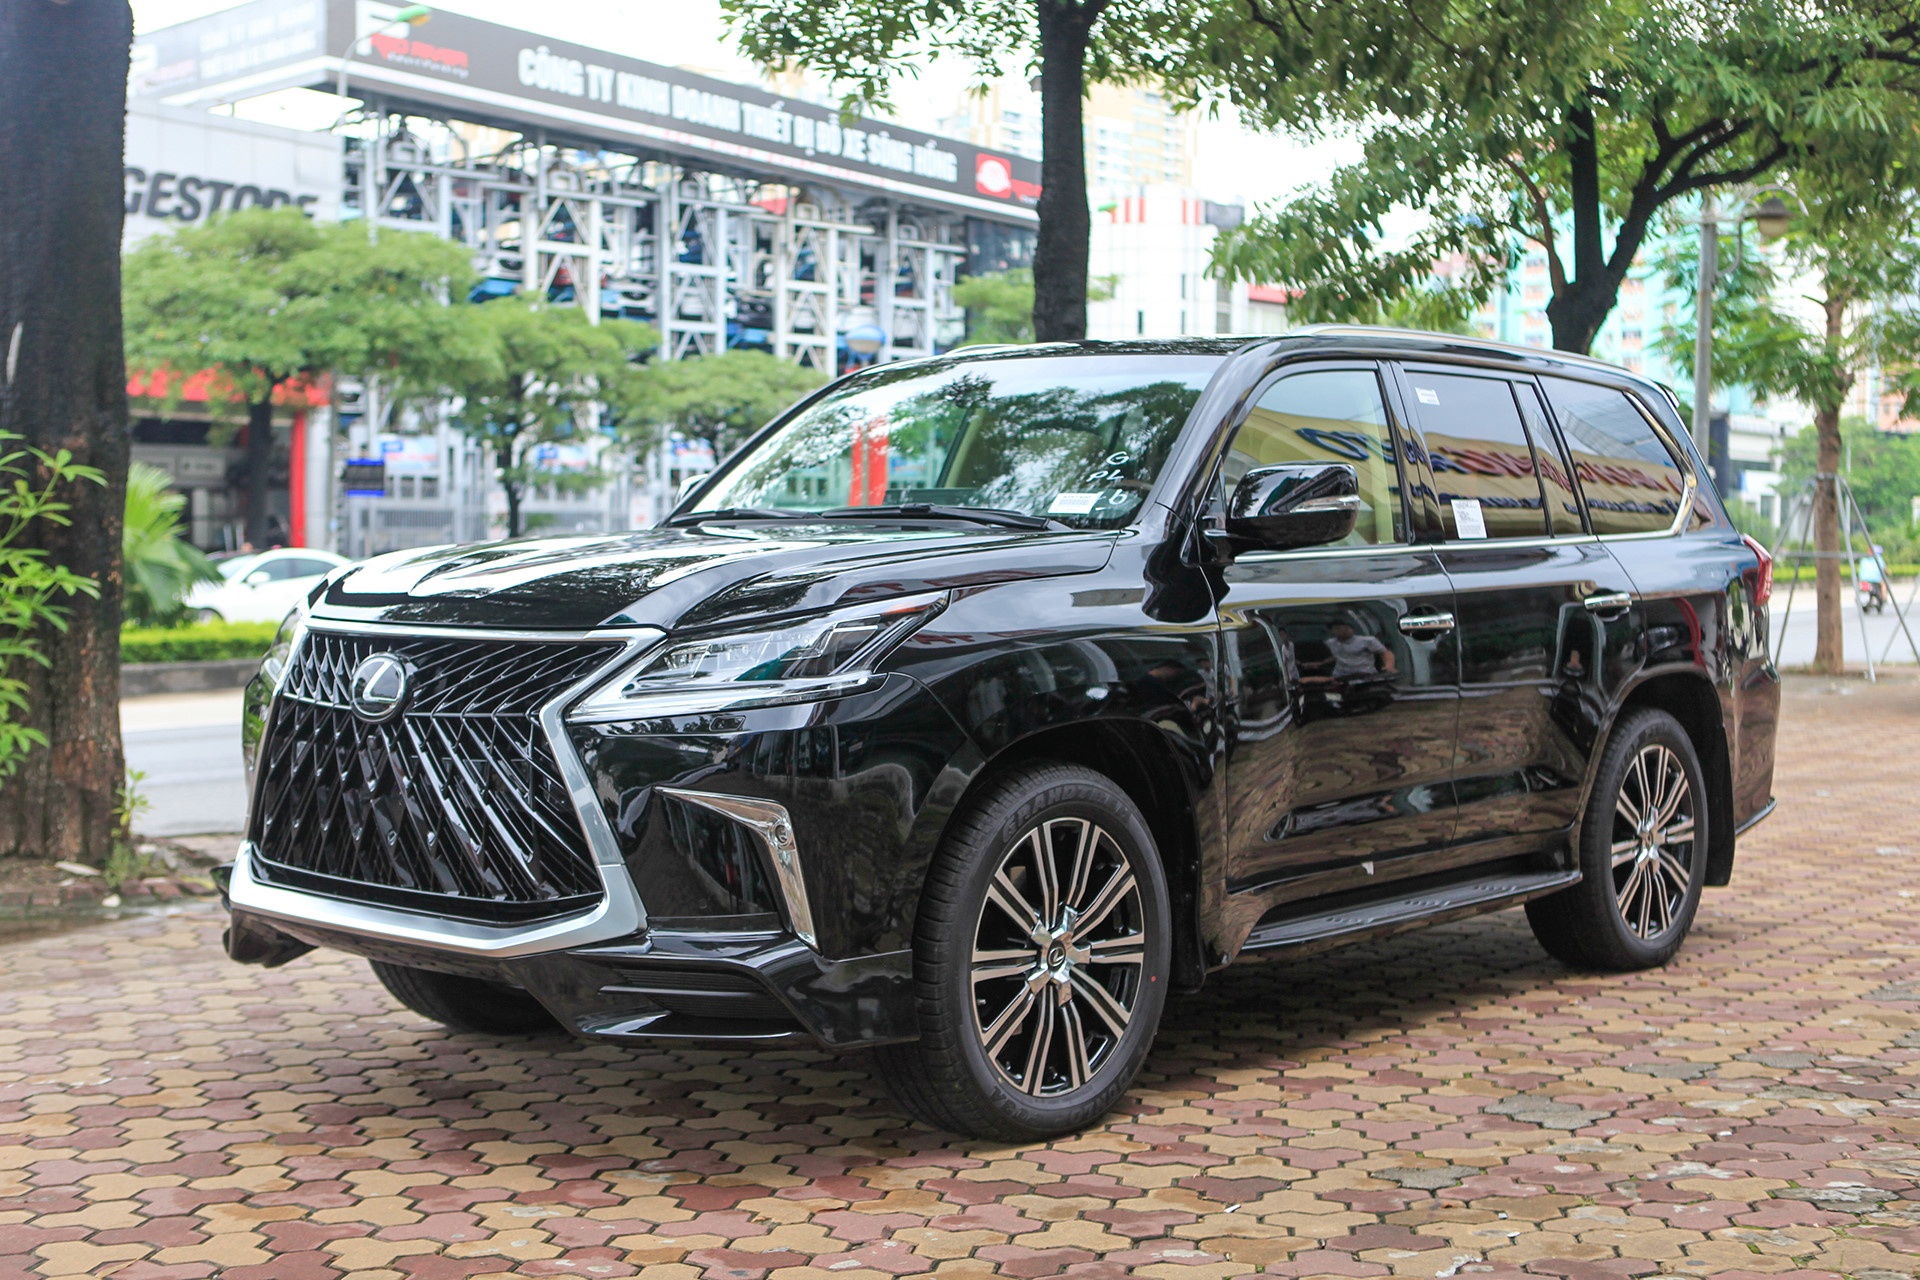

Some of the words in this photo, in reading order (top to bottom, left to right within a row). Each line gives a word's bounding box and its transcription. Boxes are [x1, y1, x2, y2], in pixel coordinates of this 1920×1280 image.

[518, 45, 584, 97] CÔNG
[585, 64, 615, 103] TY
[1106, 451, 1129, 465] G
